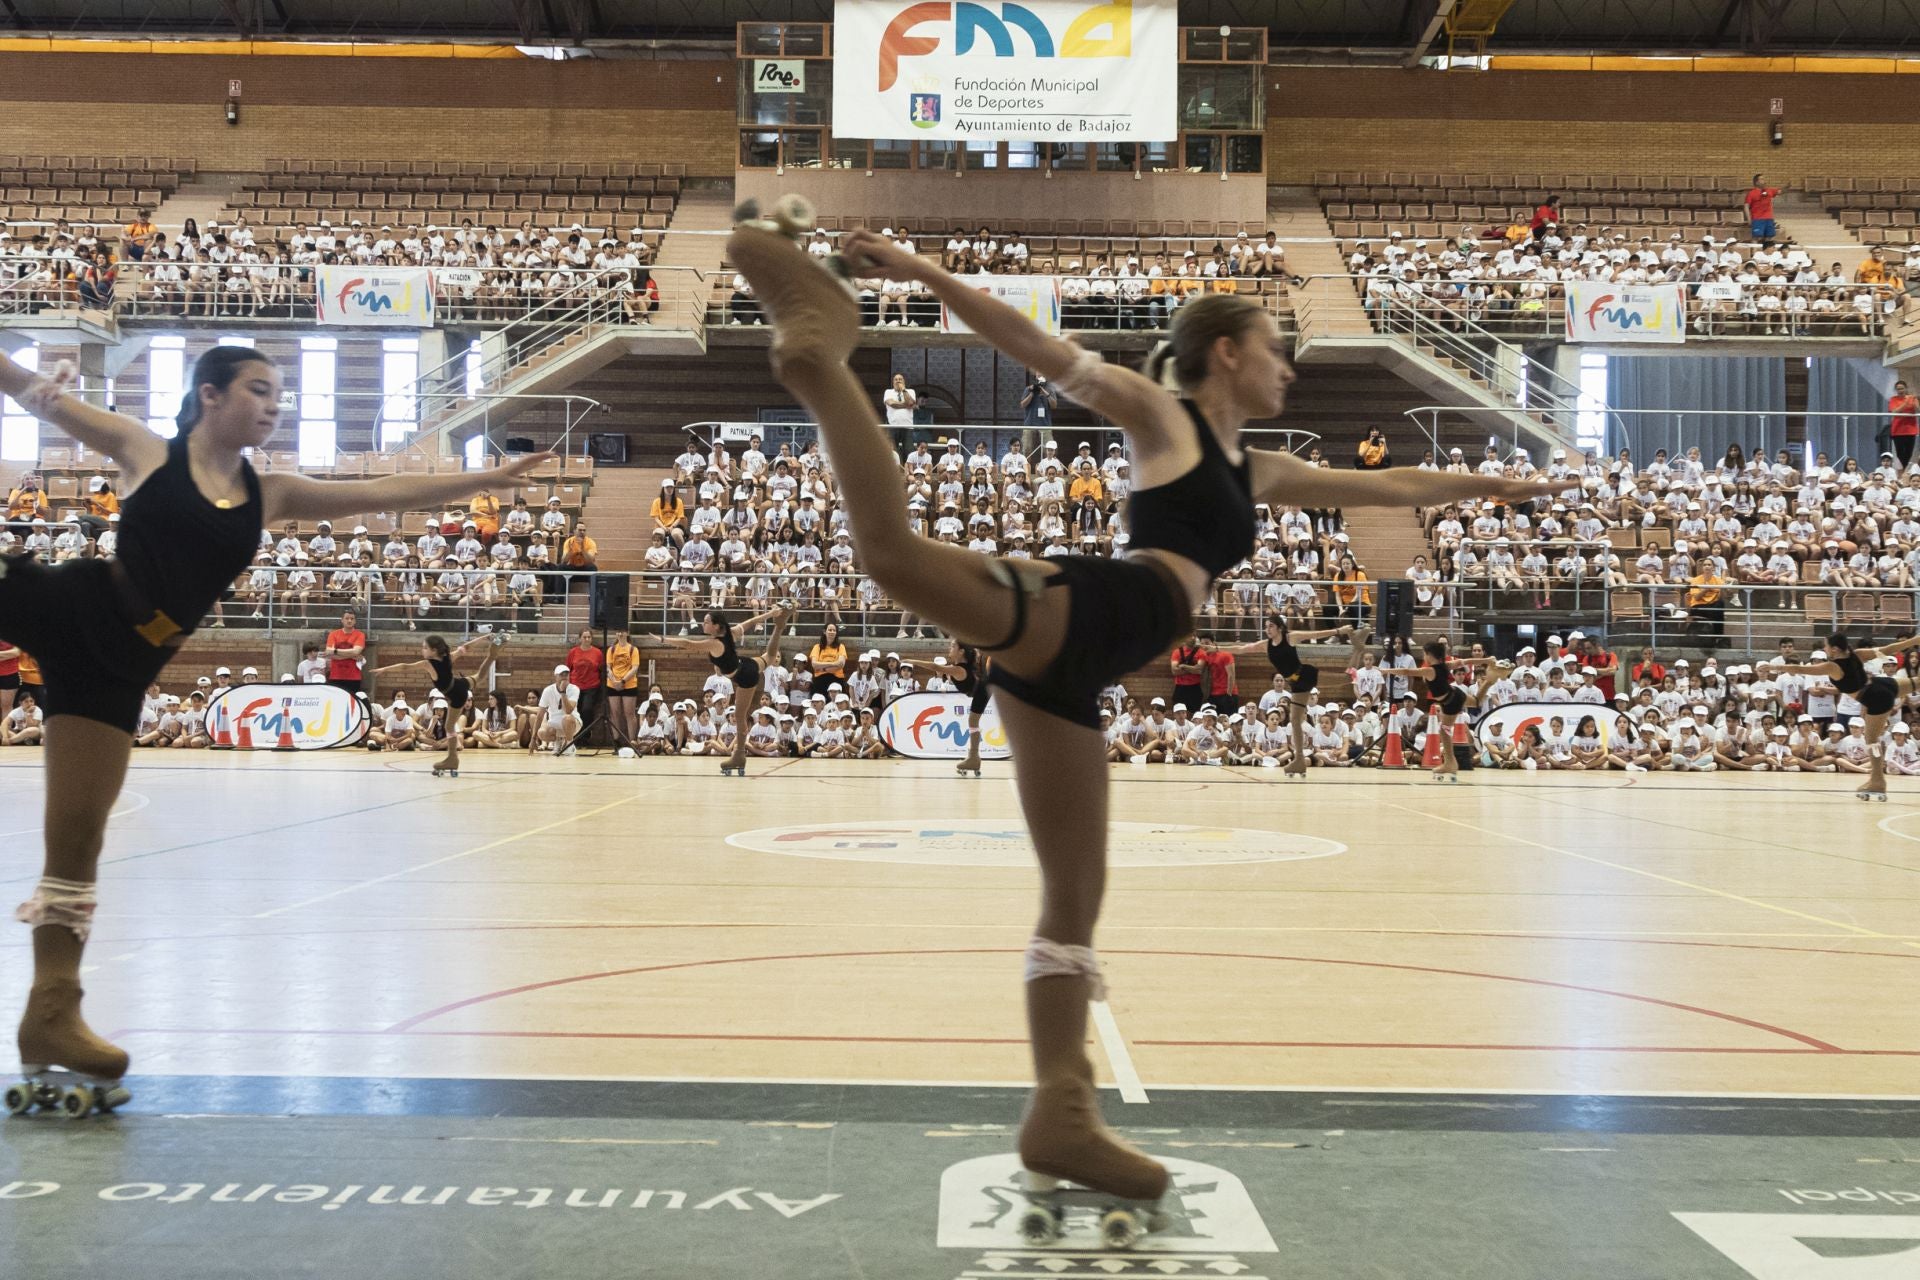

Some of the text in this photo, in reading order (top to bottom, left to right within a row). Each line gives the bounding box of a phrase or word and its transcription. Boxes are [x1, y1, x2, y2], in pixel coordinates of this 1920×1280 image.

[954, 77, 1099, 92] Fundación Municipal
[954, 95, 1044, 111] de Deportes
[954, 118, 1132, 132] Ayuntamiento de Badajoz
[97, 1181, 844, 1218] Ayuntamiento
